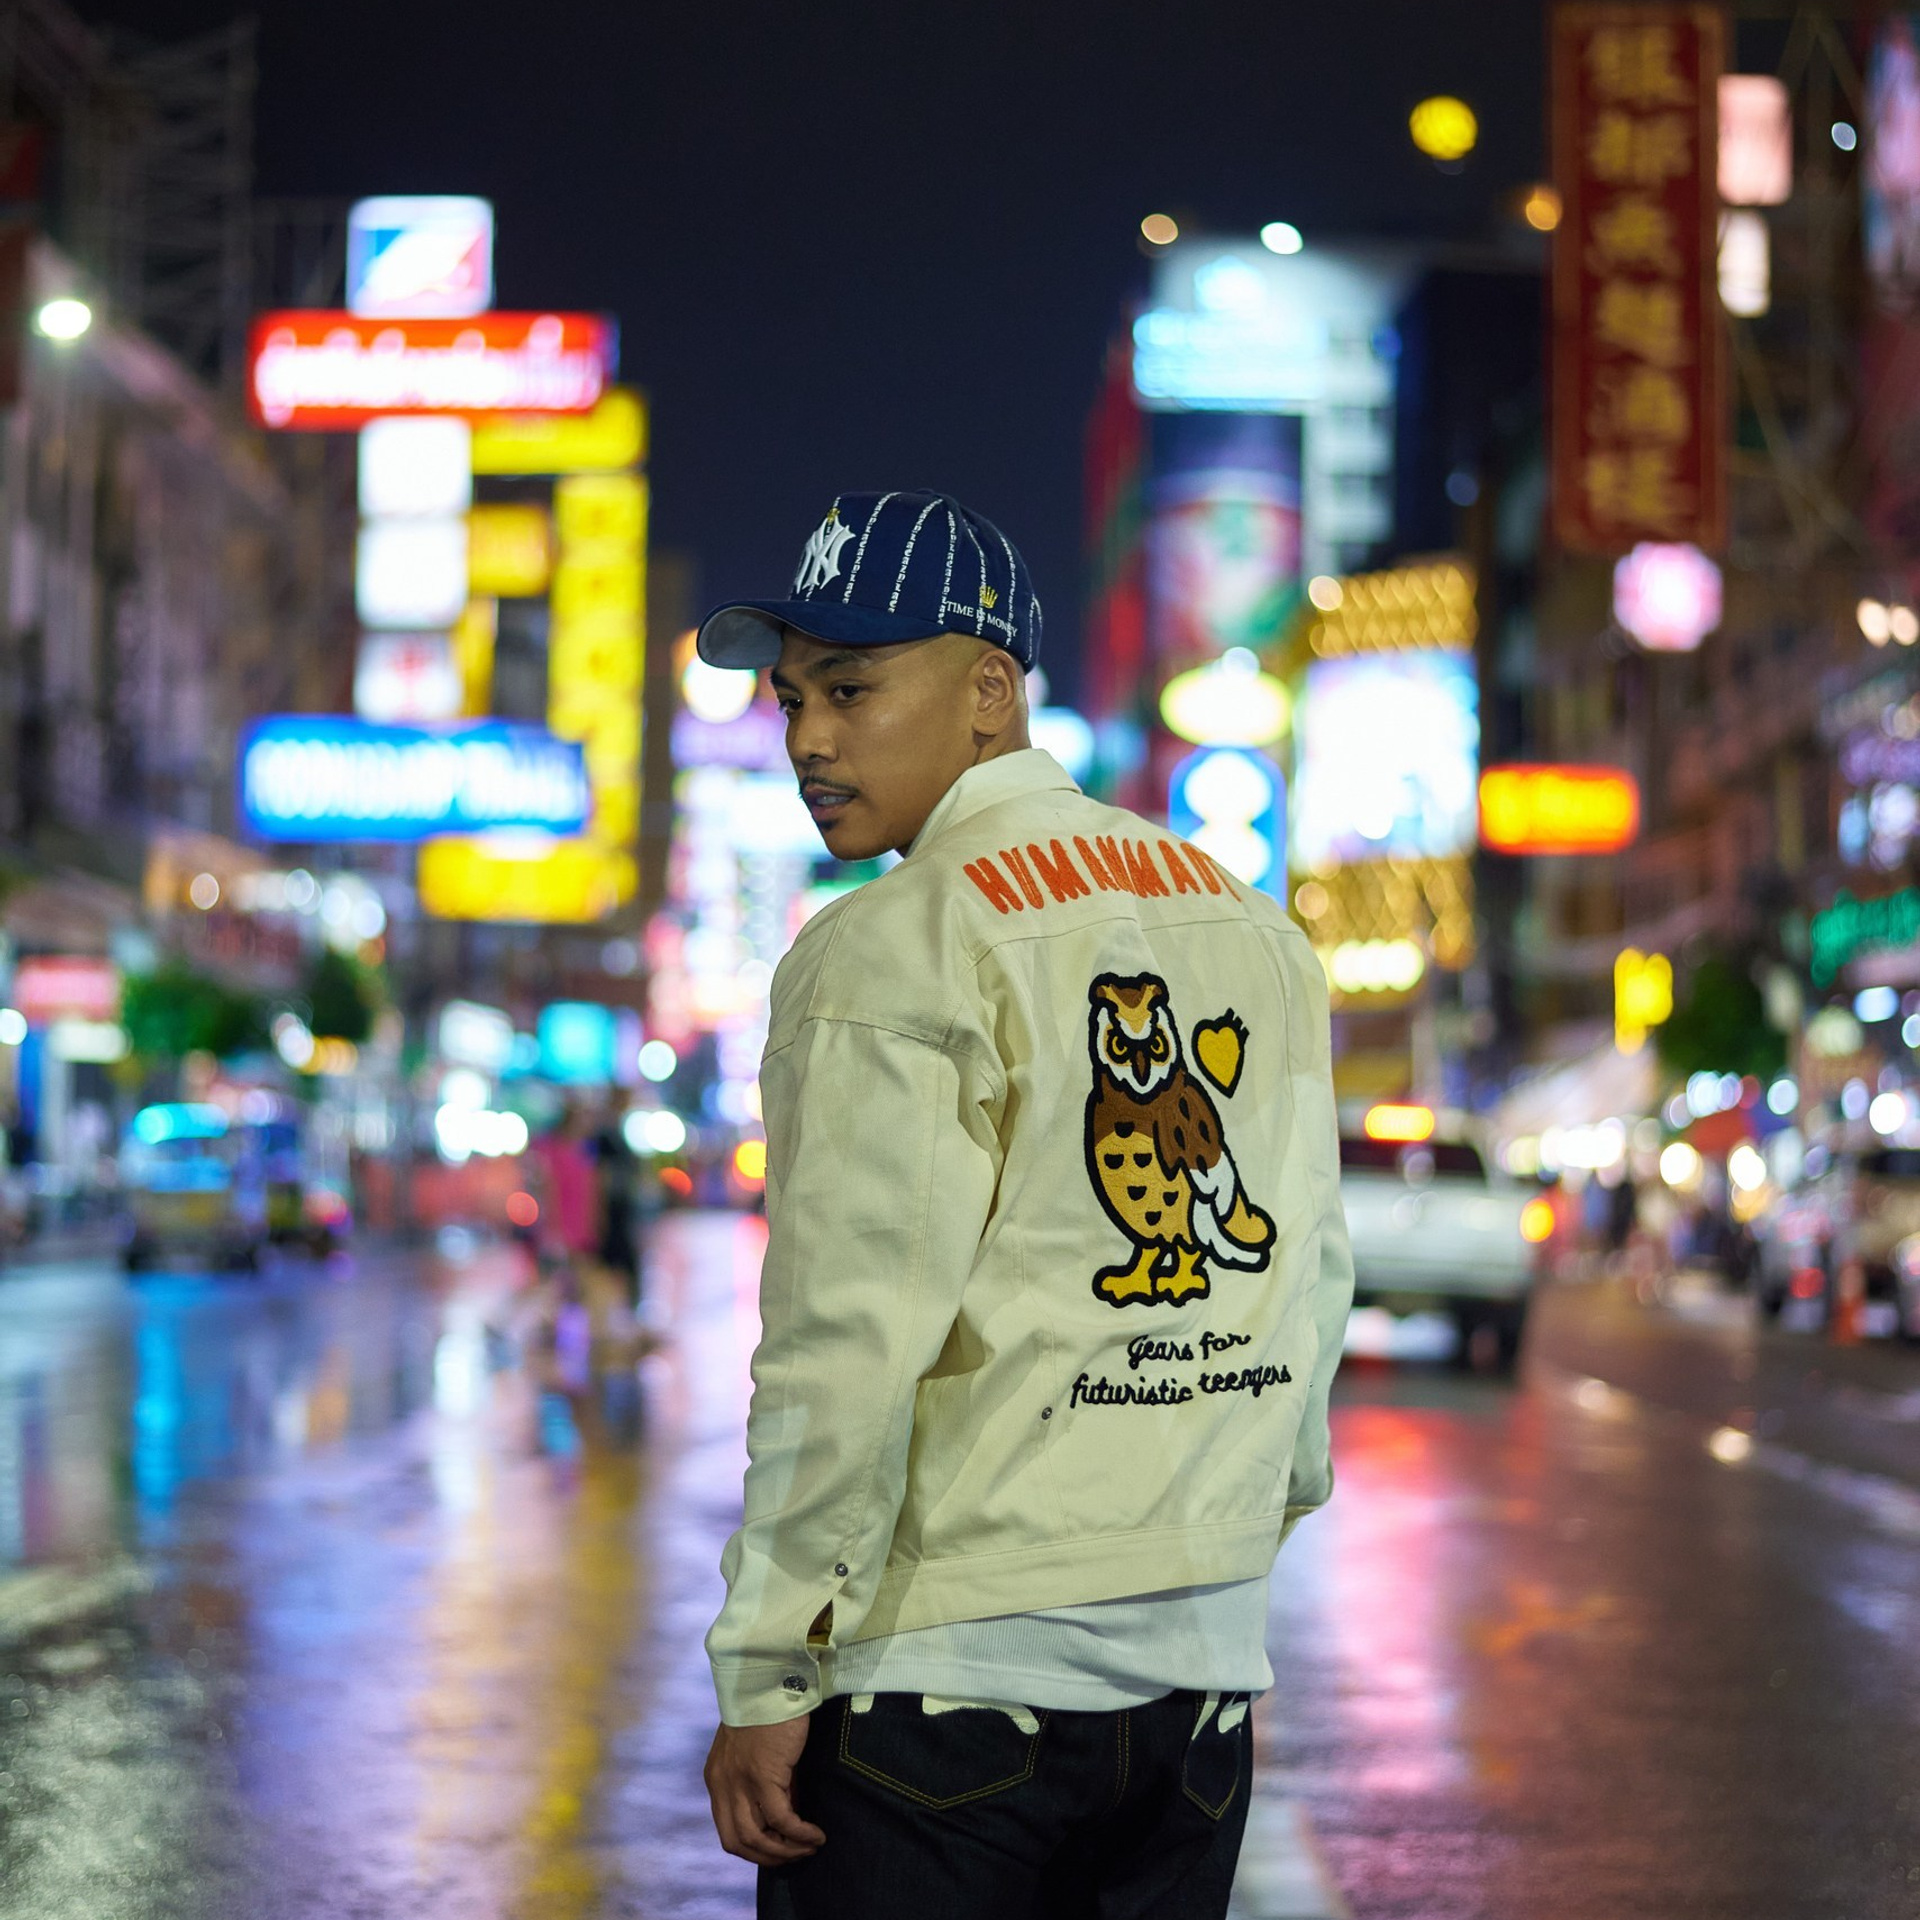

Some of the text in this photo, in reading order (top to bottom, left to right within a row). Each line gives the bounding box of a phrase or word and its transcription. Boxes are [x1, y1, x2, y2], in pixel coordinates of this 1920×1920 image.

[946, 600, 974, 618] TIME
[1199, 1331, 1252, 1361] for
[1069, 1372, 1194, 1409] futuristic
